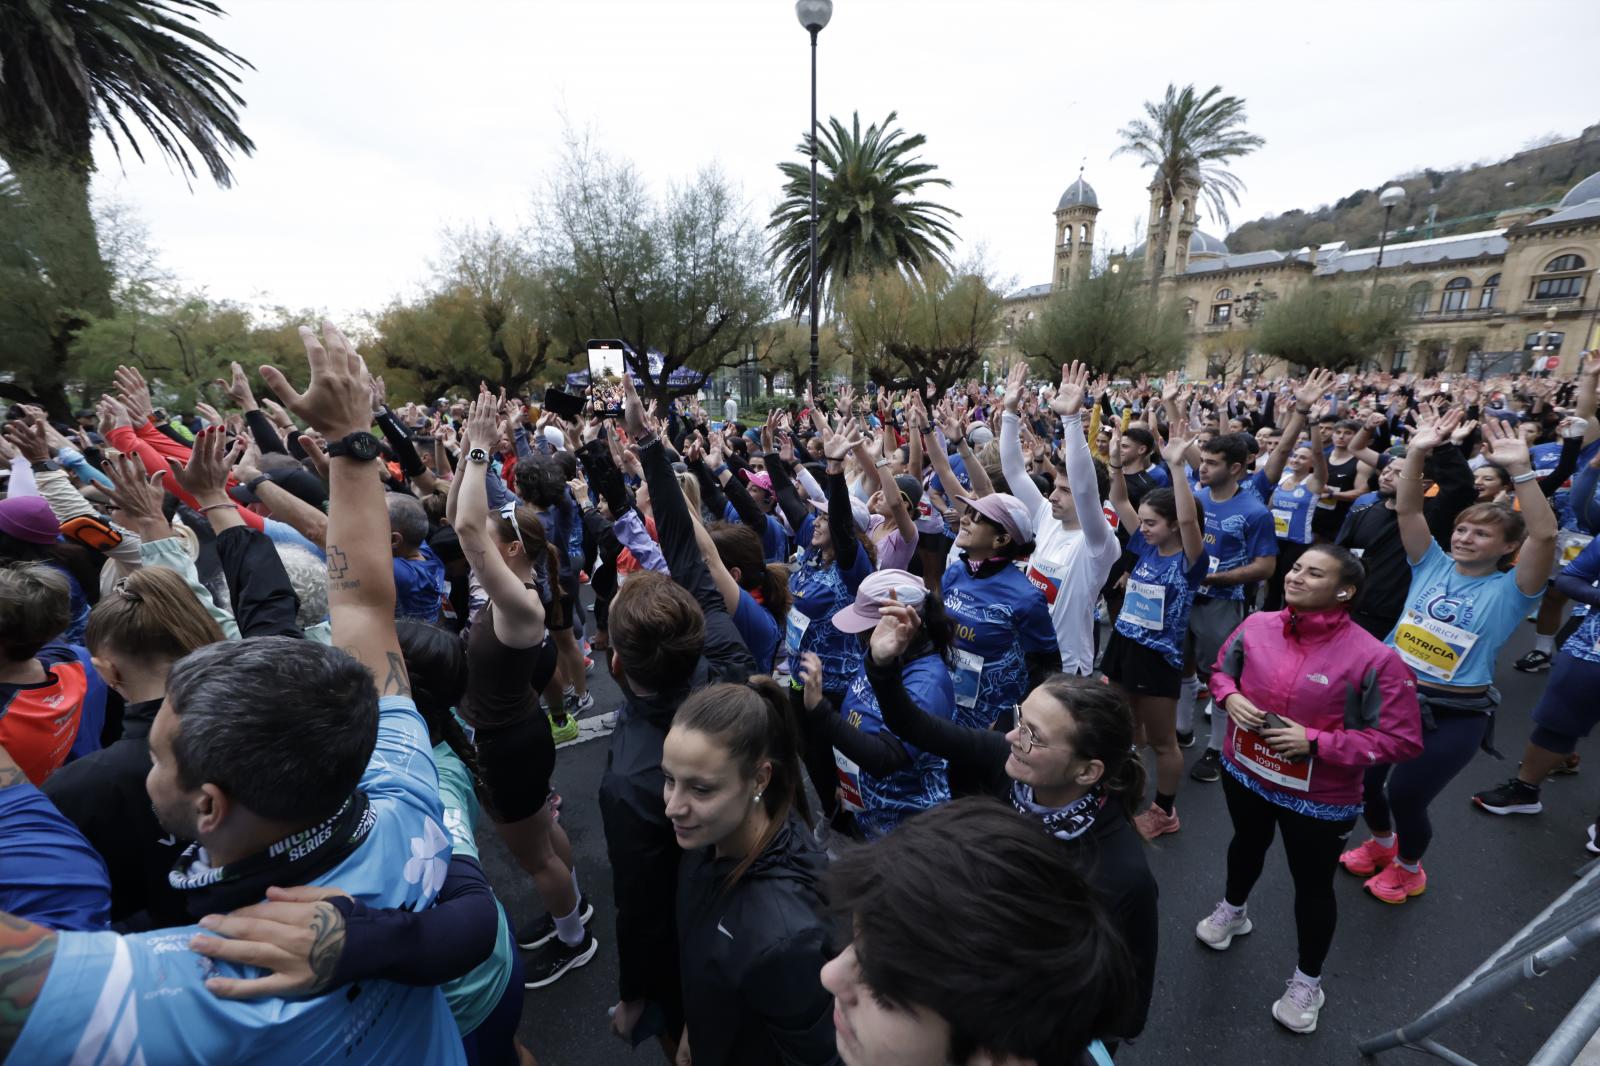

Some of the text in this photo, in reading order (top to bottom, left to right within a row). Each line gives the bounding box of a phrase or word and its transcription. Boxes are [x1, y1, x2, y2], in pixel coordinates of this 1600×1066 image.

[1424, 621, 1459, 641] ZURICH
[1403, 632, 1455, 661] PATRICIA
[1255, 754, 1281, 772] 10919
[289, 826, 333, 862] SERIES
